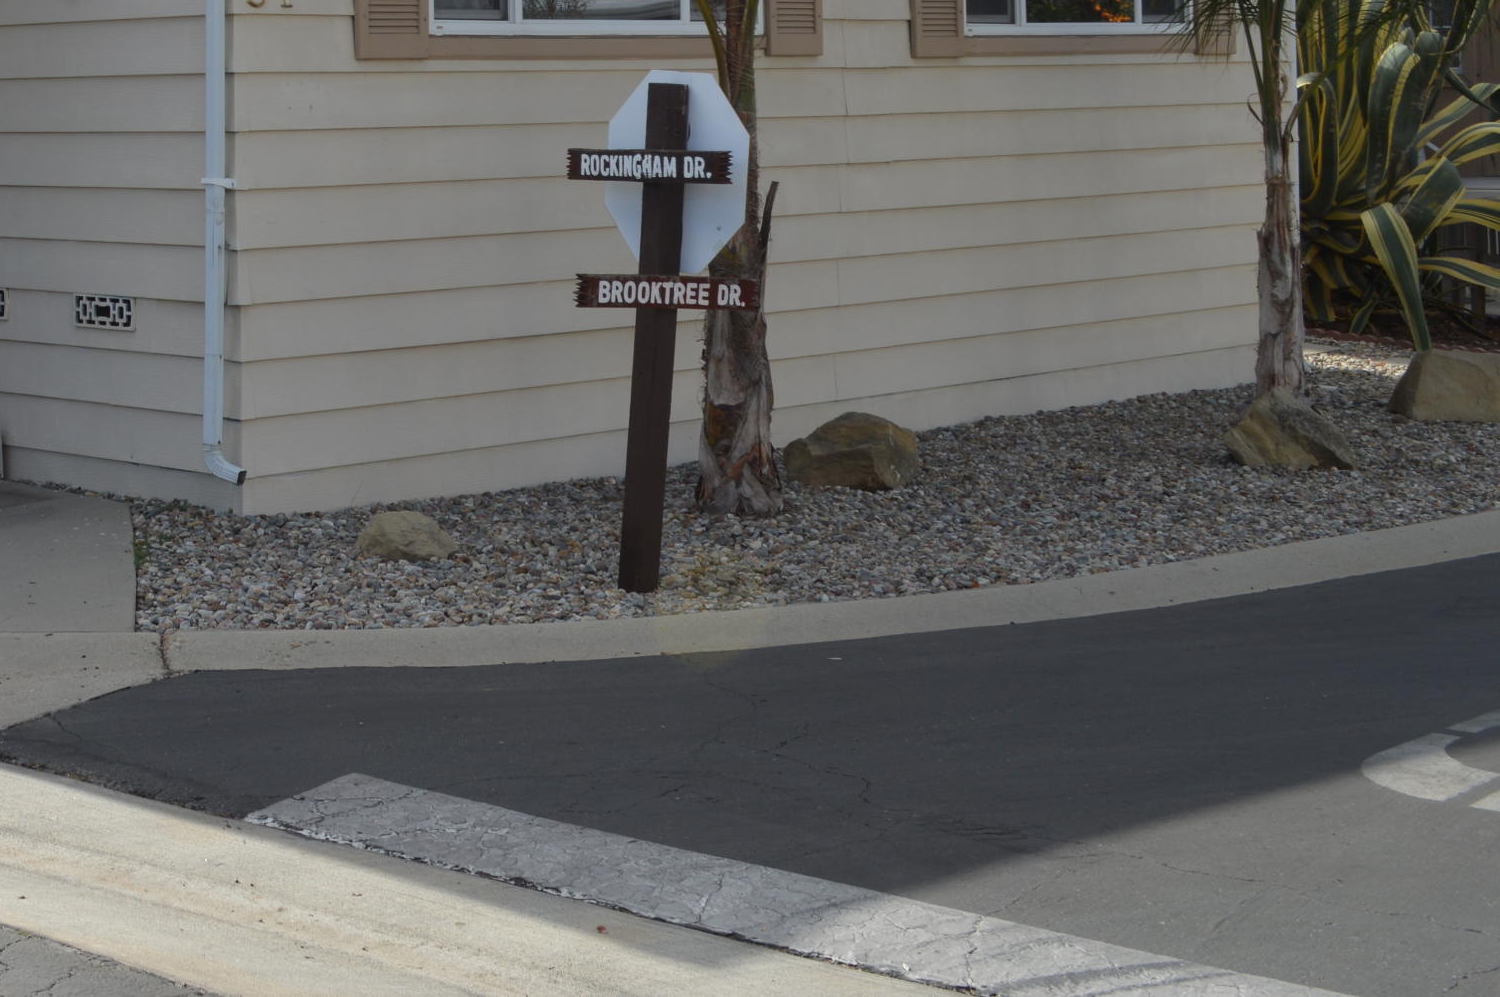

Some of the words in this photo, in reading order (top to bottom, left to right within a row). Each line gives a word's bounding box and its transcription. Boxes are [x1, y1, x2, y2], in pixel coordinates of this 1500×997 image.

[580, 153, 677, 180] ROCKINGHAM
[682, 155, 713, 179] DR.
[597, 280, 710, 306] BROOKTREE
[716, 283, 746, 308] DR.
